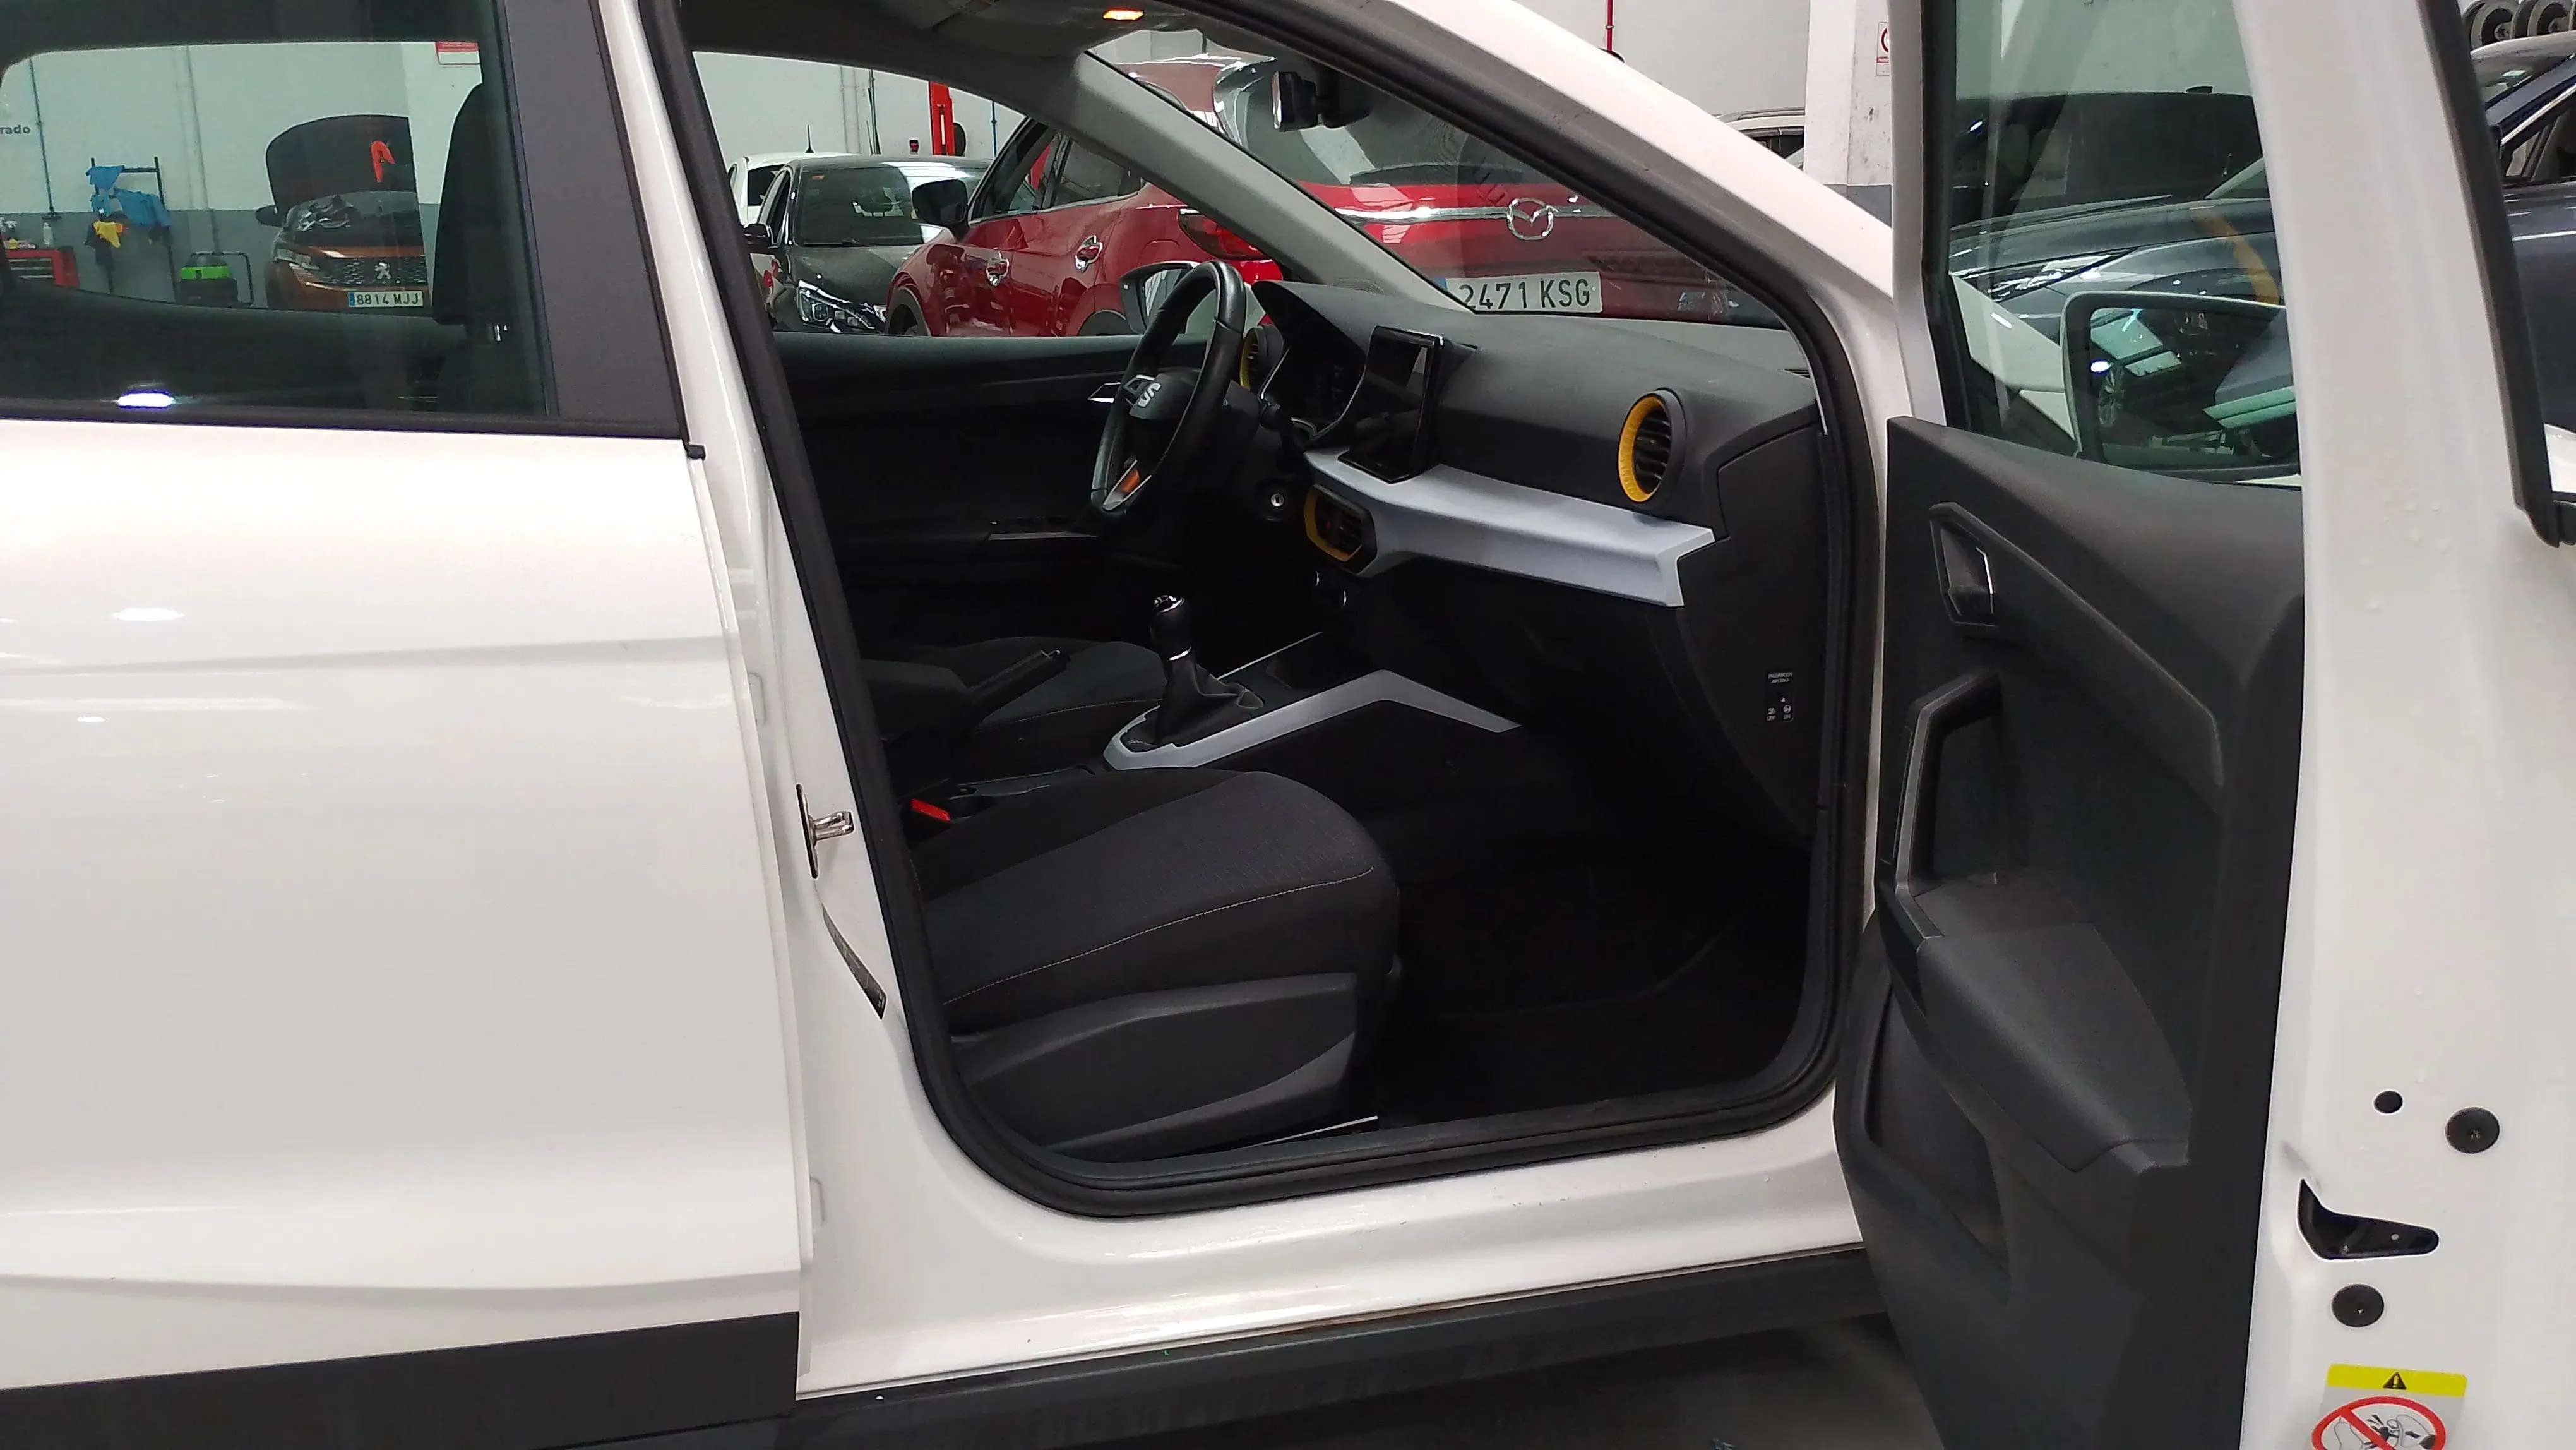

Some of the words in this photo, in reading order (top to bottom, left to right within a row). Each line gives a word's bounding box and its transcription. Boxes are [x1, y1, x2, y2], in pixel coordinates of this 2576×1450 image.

[356, 293, 390, 305] 8814
[393, 292, 419, 304] MJJ
[1458, 282, 1528, 309] 2471
[1540, 278, 1590, 308] KSG
